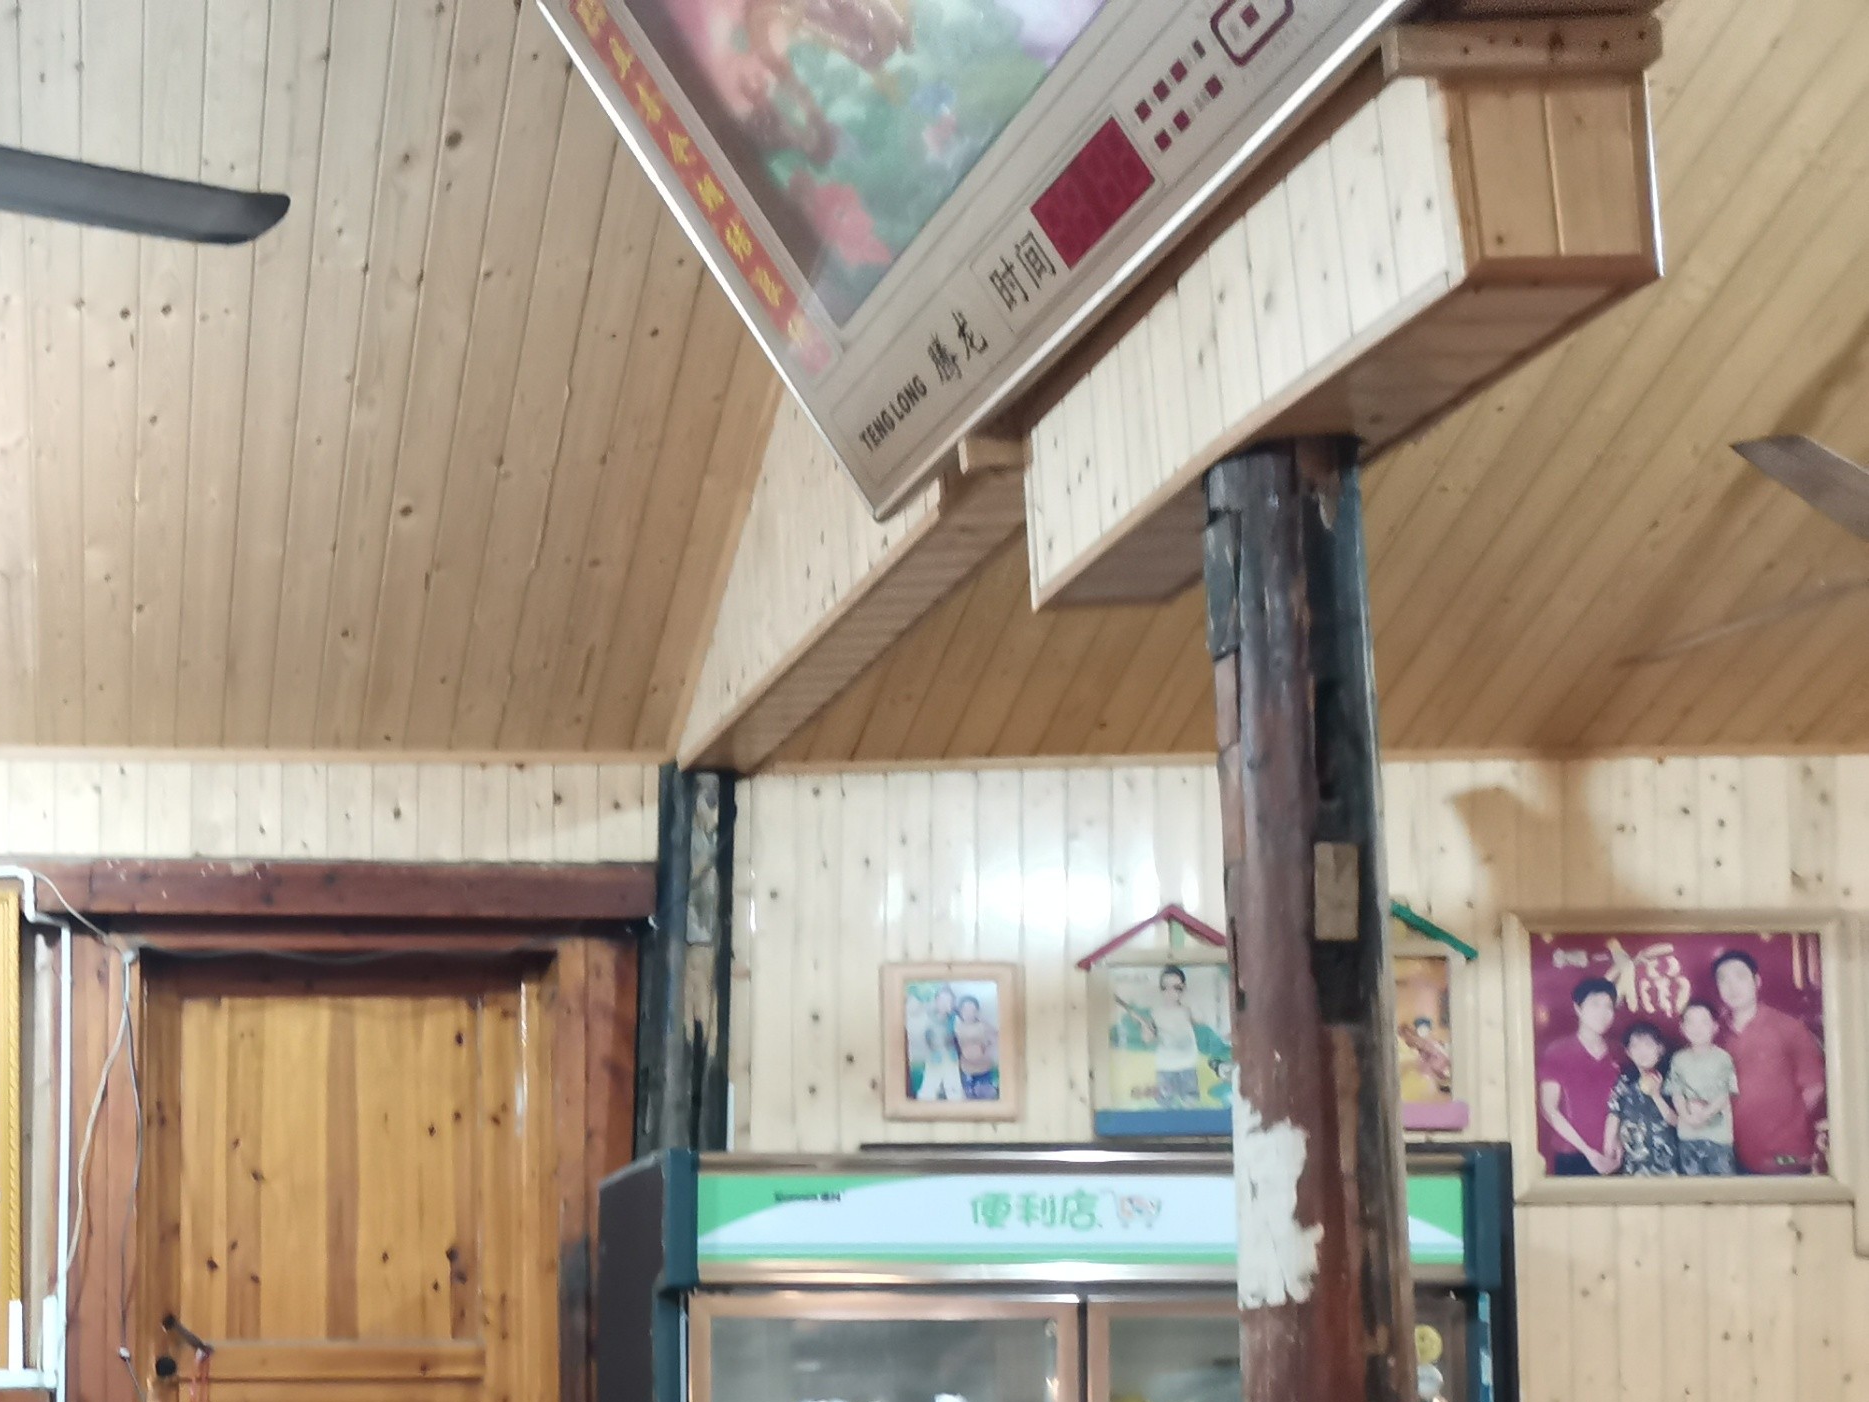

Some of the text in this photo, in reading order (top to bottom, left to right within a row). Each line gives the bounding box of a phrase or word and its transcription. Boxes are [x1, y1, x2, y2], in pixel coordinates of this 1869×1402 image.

[988, 229, 1057, 312] 时间
[859, 373, 928, 452] TENG LONG
